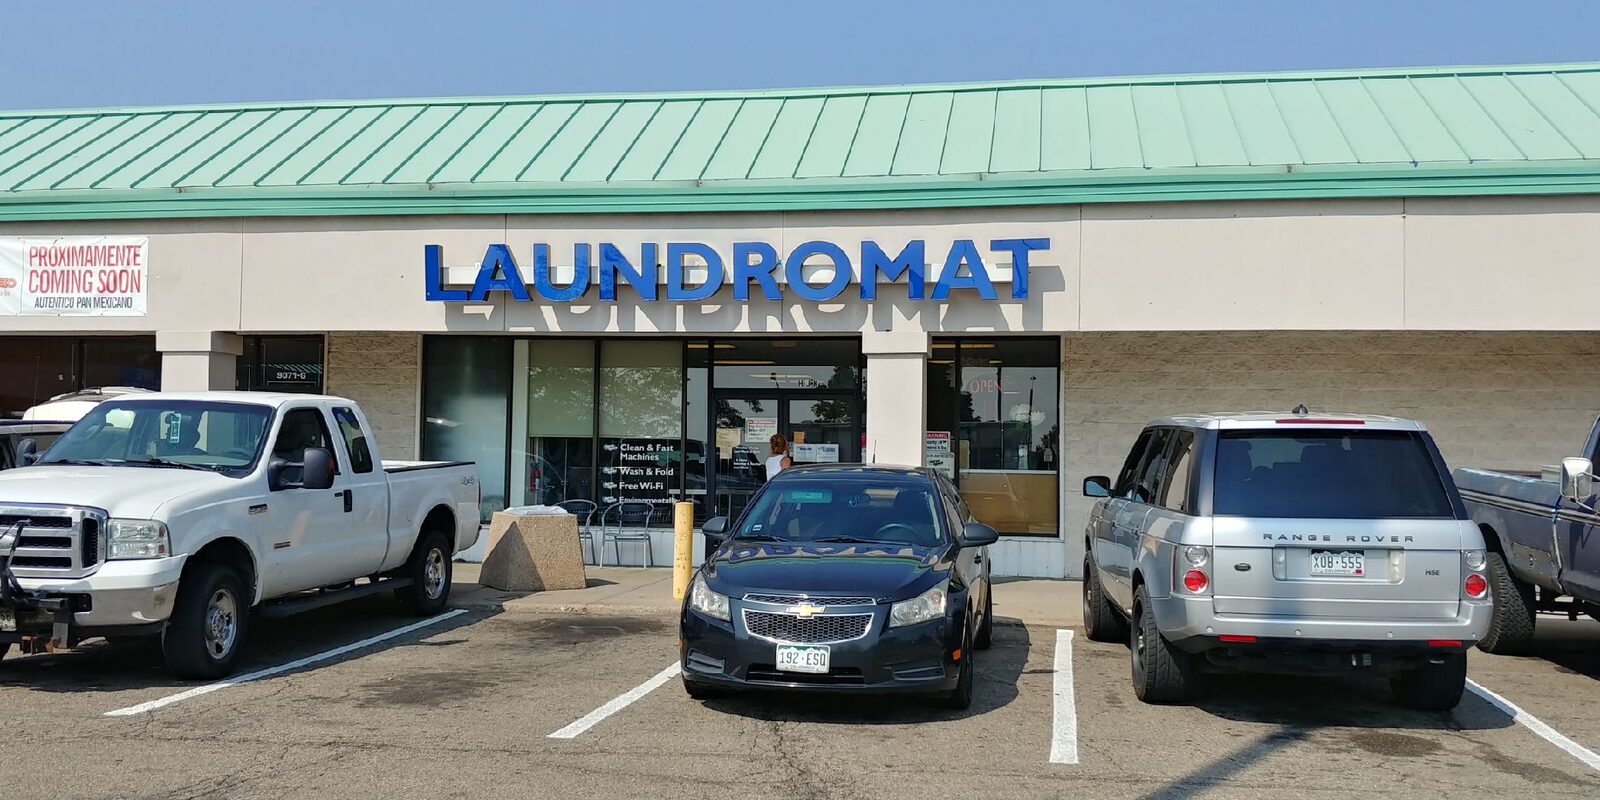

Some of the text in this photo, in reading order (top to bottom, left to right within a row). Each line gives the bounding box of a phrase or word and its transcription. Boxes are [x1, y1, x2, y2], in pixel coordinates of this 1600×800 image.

[28, 239, 142, 267] PRÓXIMAMENTE
[424, 237, 1051, 302] LAUNDROMAT
[28, 269, 94, 294] COMING
[96, 269, 141, 294] SOON
[34, 296, 133, 309] AUTENTICO PAN MEXICANO
[276, 371, 306, 379] 9071-G
[969, 379, 1003, 394] OPEN
[620, 443, 674, 452] Clean & Fast
[620, 452, 660, 461] Machines
[620, 467, 674, 476] Wash & Fold
[619, 481, 664, 490] Free Wi-Fi
[1263, 533, 1414, 543] RANGE ROVER
